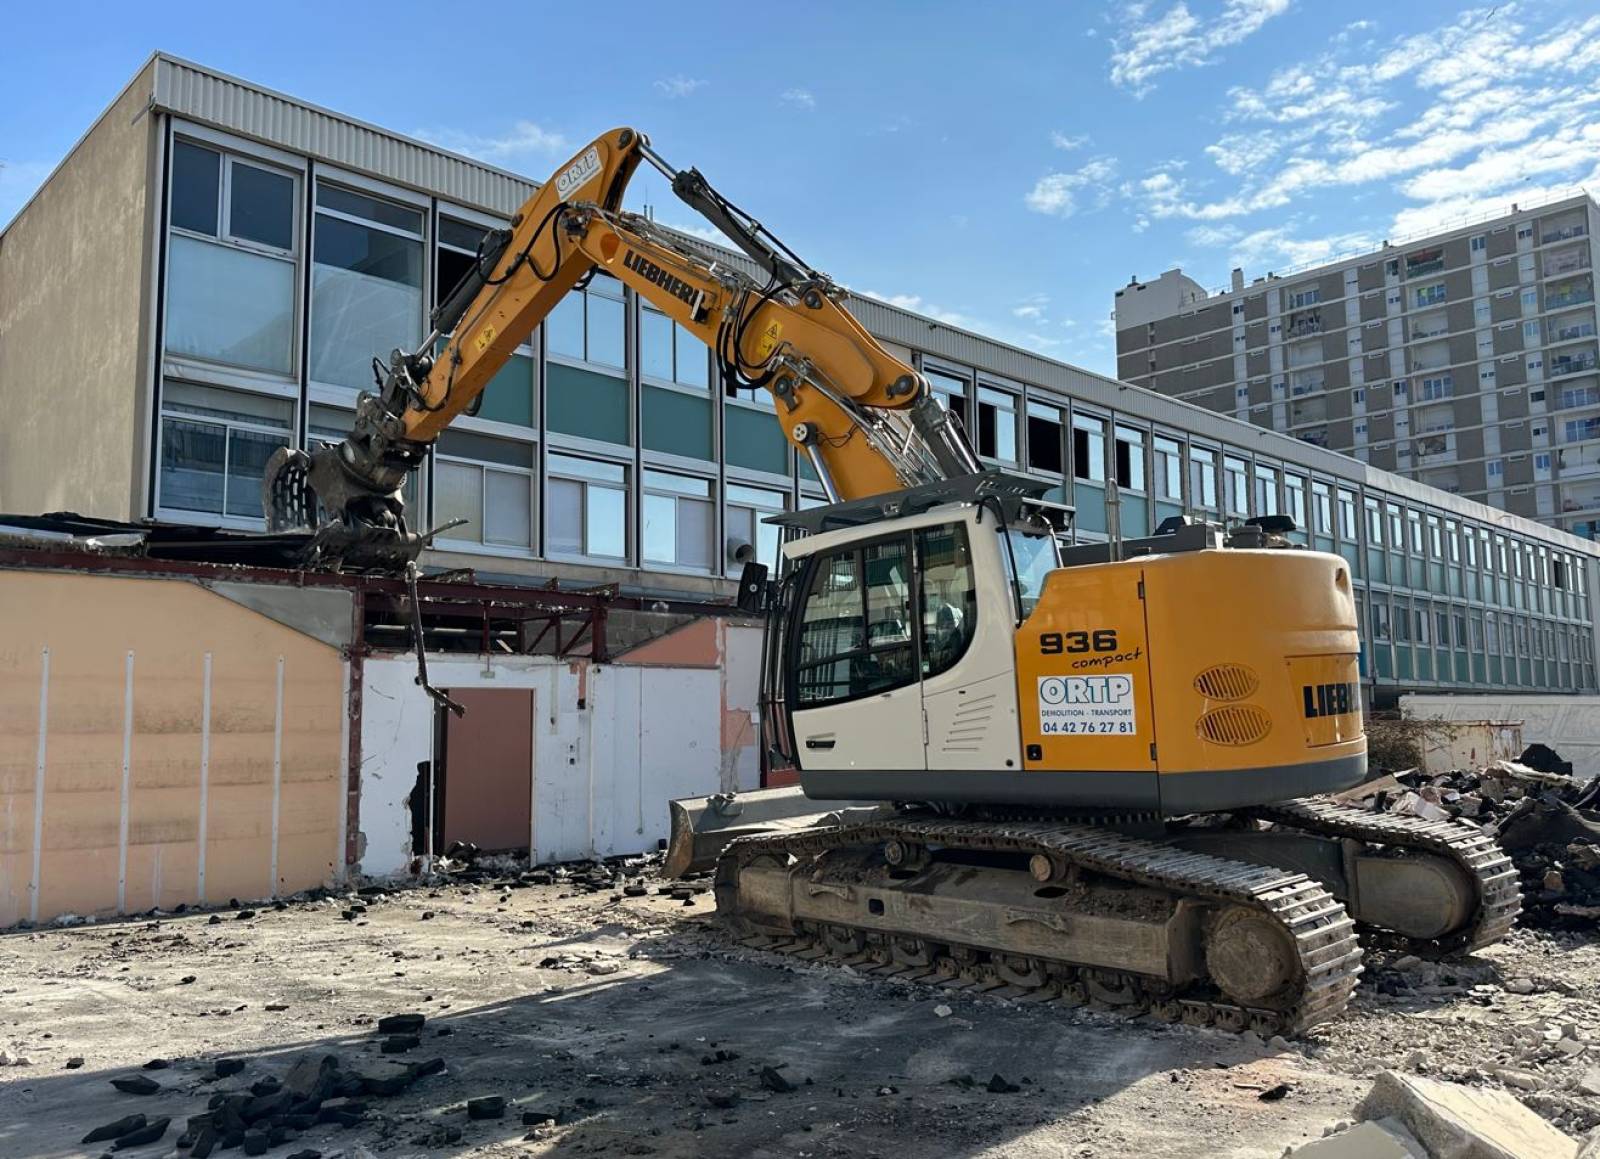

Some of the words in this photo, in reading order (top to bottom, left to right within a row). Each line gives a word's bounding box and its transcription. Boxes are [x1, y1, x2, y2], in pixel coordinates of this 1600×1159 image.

[557, 149, 598, 191] ORTP
[1040, 629, 1117, 654] 936
[1071, 647, 1143, 668] compact
[1040, 676, 1131, 704] ORTP
[1041, 709, 1084, 717] DEMOLITION
[1043, 722, 1058, 733] 04
[1061, 722, 1076, 733] 42
[1080, 722, 1095, 733] 76
[1099, 722, 1115, 733] 27
[1119, 722, 1133, 733] 81
